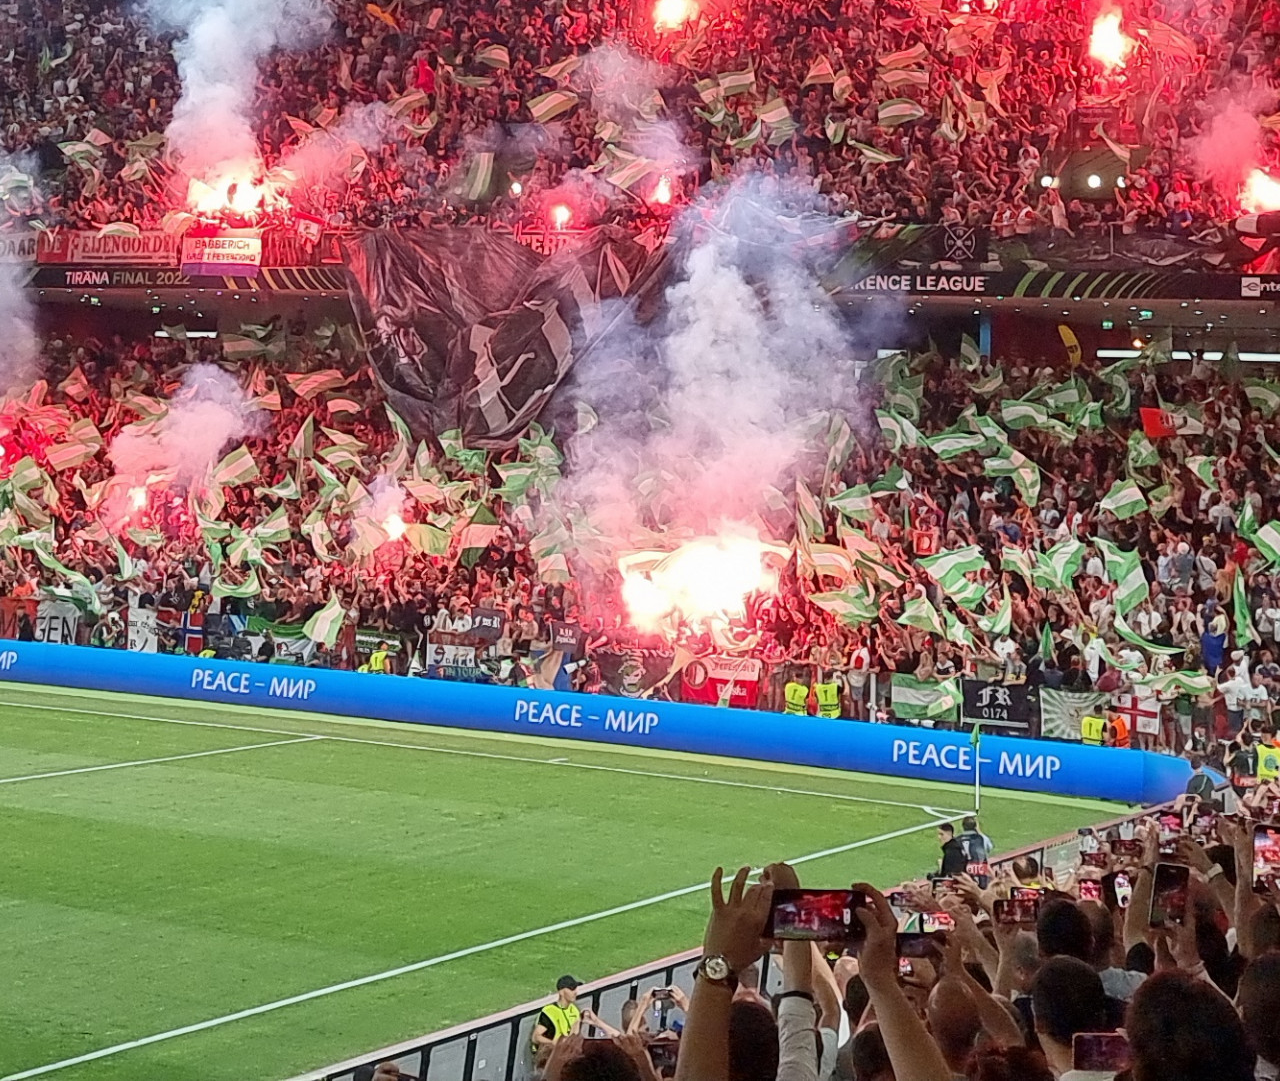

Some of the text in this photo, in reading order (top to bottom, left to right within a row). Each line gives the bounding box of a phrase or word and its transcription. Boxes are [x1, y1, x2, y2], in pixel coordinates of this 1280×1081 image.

[65, 270, 110, 285] TIRANA
[113, 271, 154, 285] FINAL
[916, 275, 986, 292] LEAGUE
[192, 668, 251, 694] PEACE
[515, 700, 583, 727] PEACE
[982, 707, 1008, 720] 0174
[893, 739, 973, 771] PEACE
